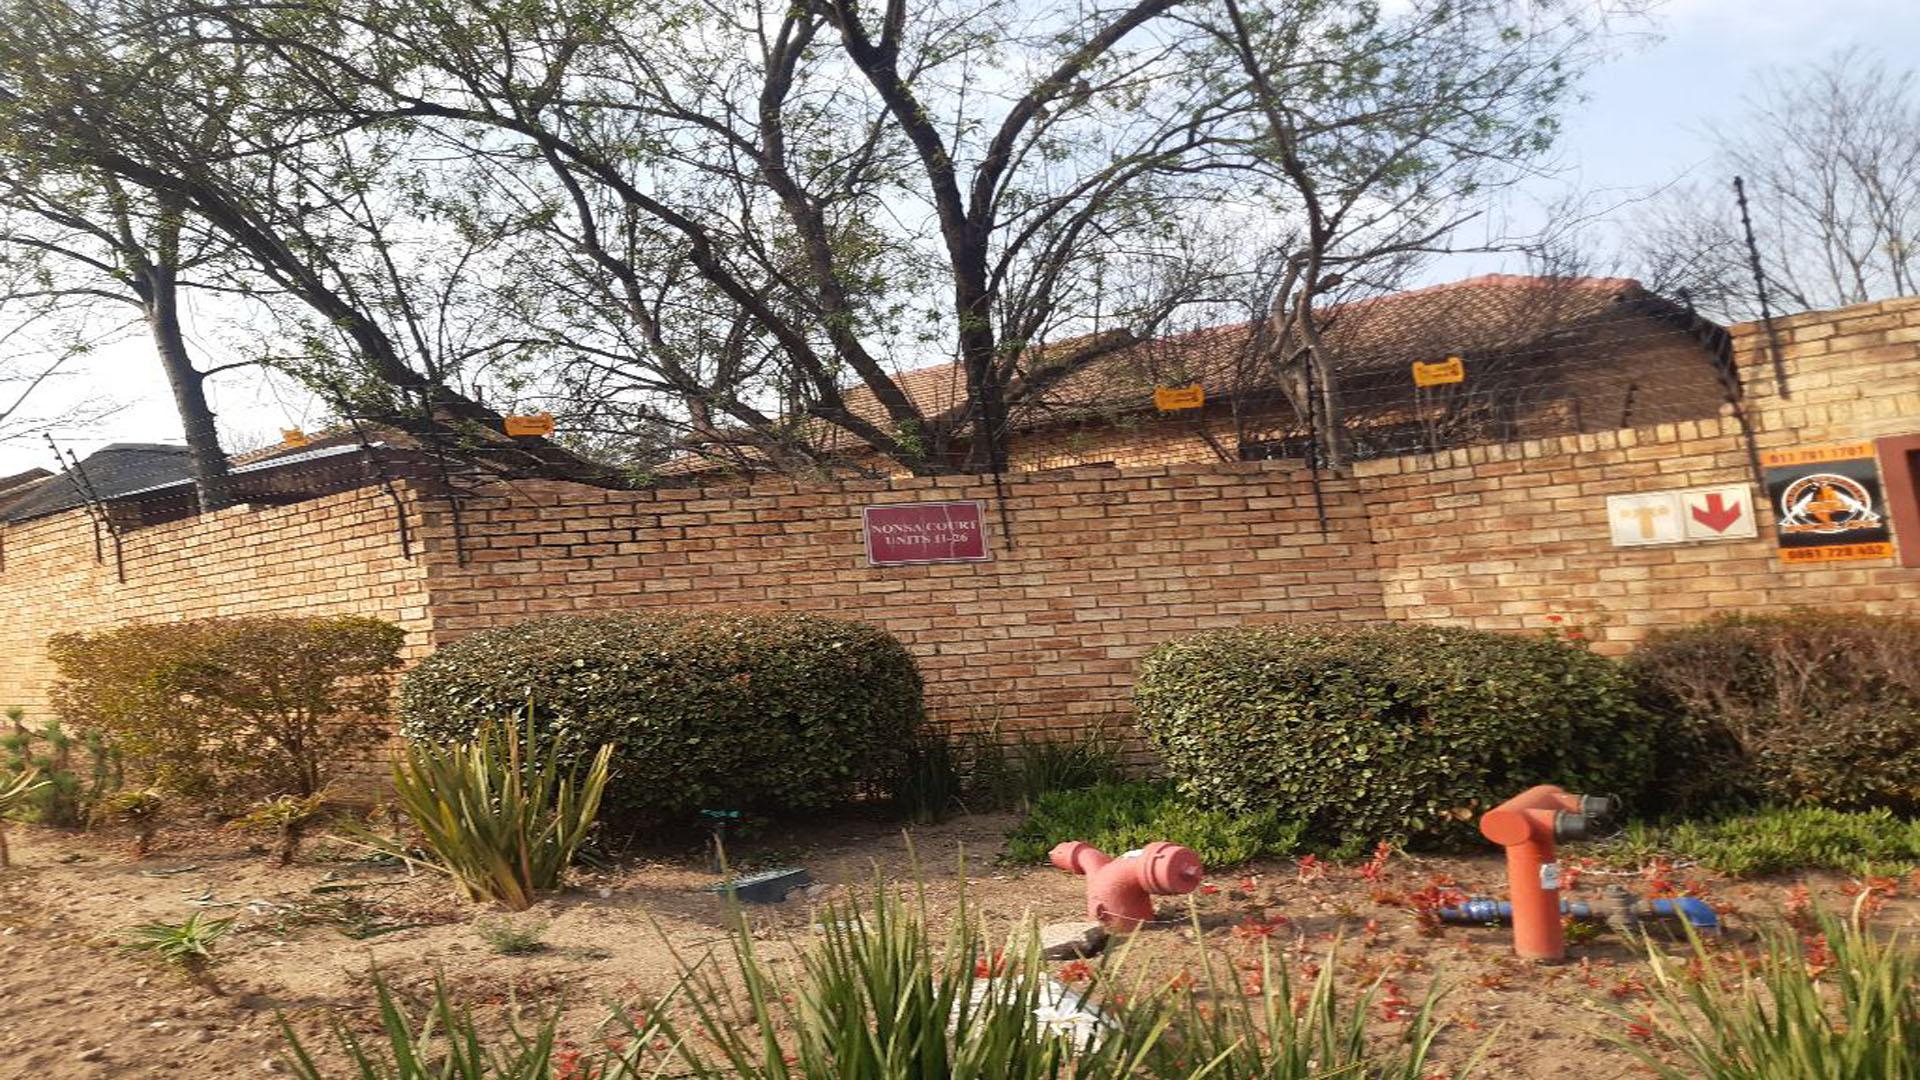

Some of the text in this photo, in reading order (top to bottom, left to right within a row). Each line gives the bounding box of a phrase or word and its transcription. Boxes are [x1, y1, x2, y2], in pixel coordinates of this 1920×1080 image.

[870, 520, 977, 534] NONSA COURT
[885, 533, 969, 545] UNITS 11-26
